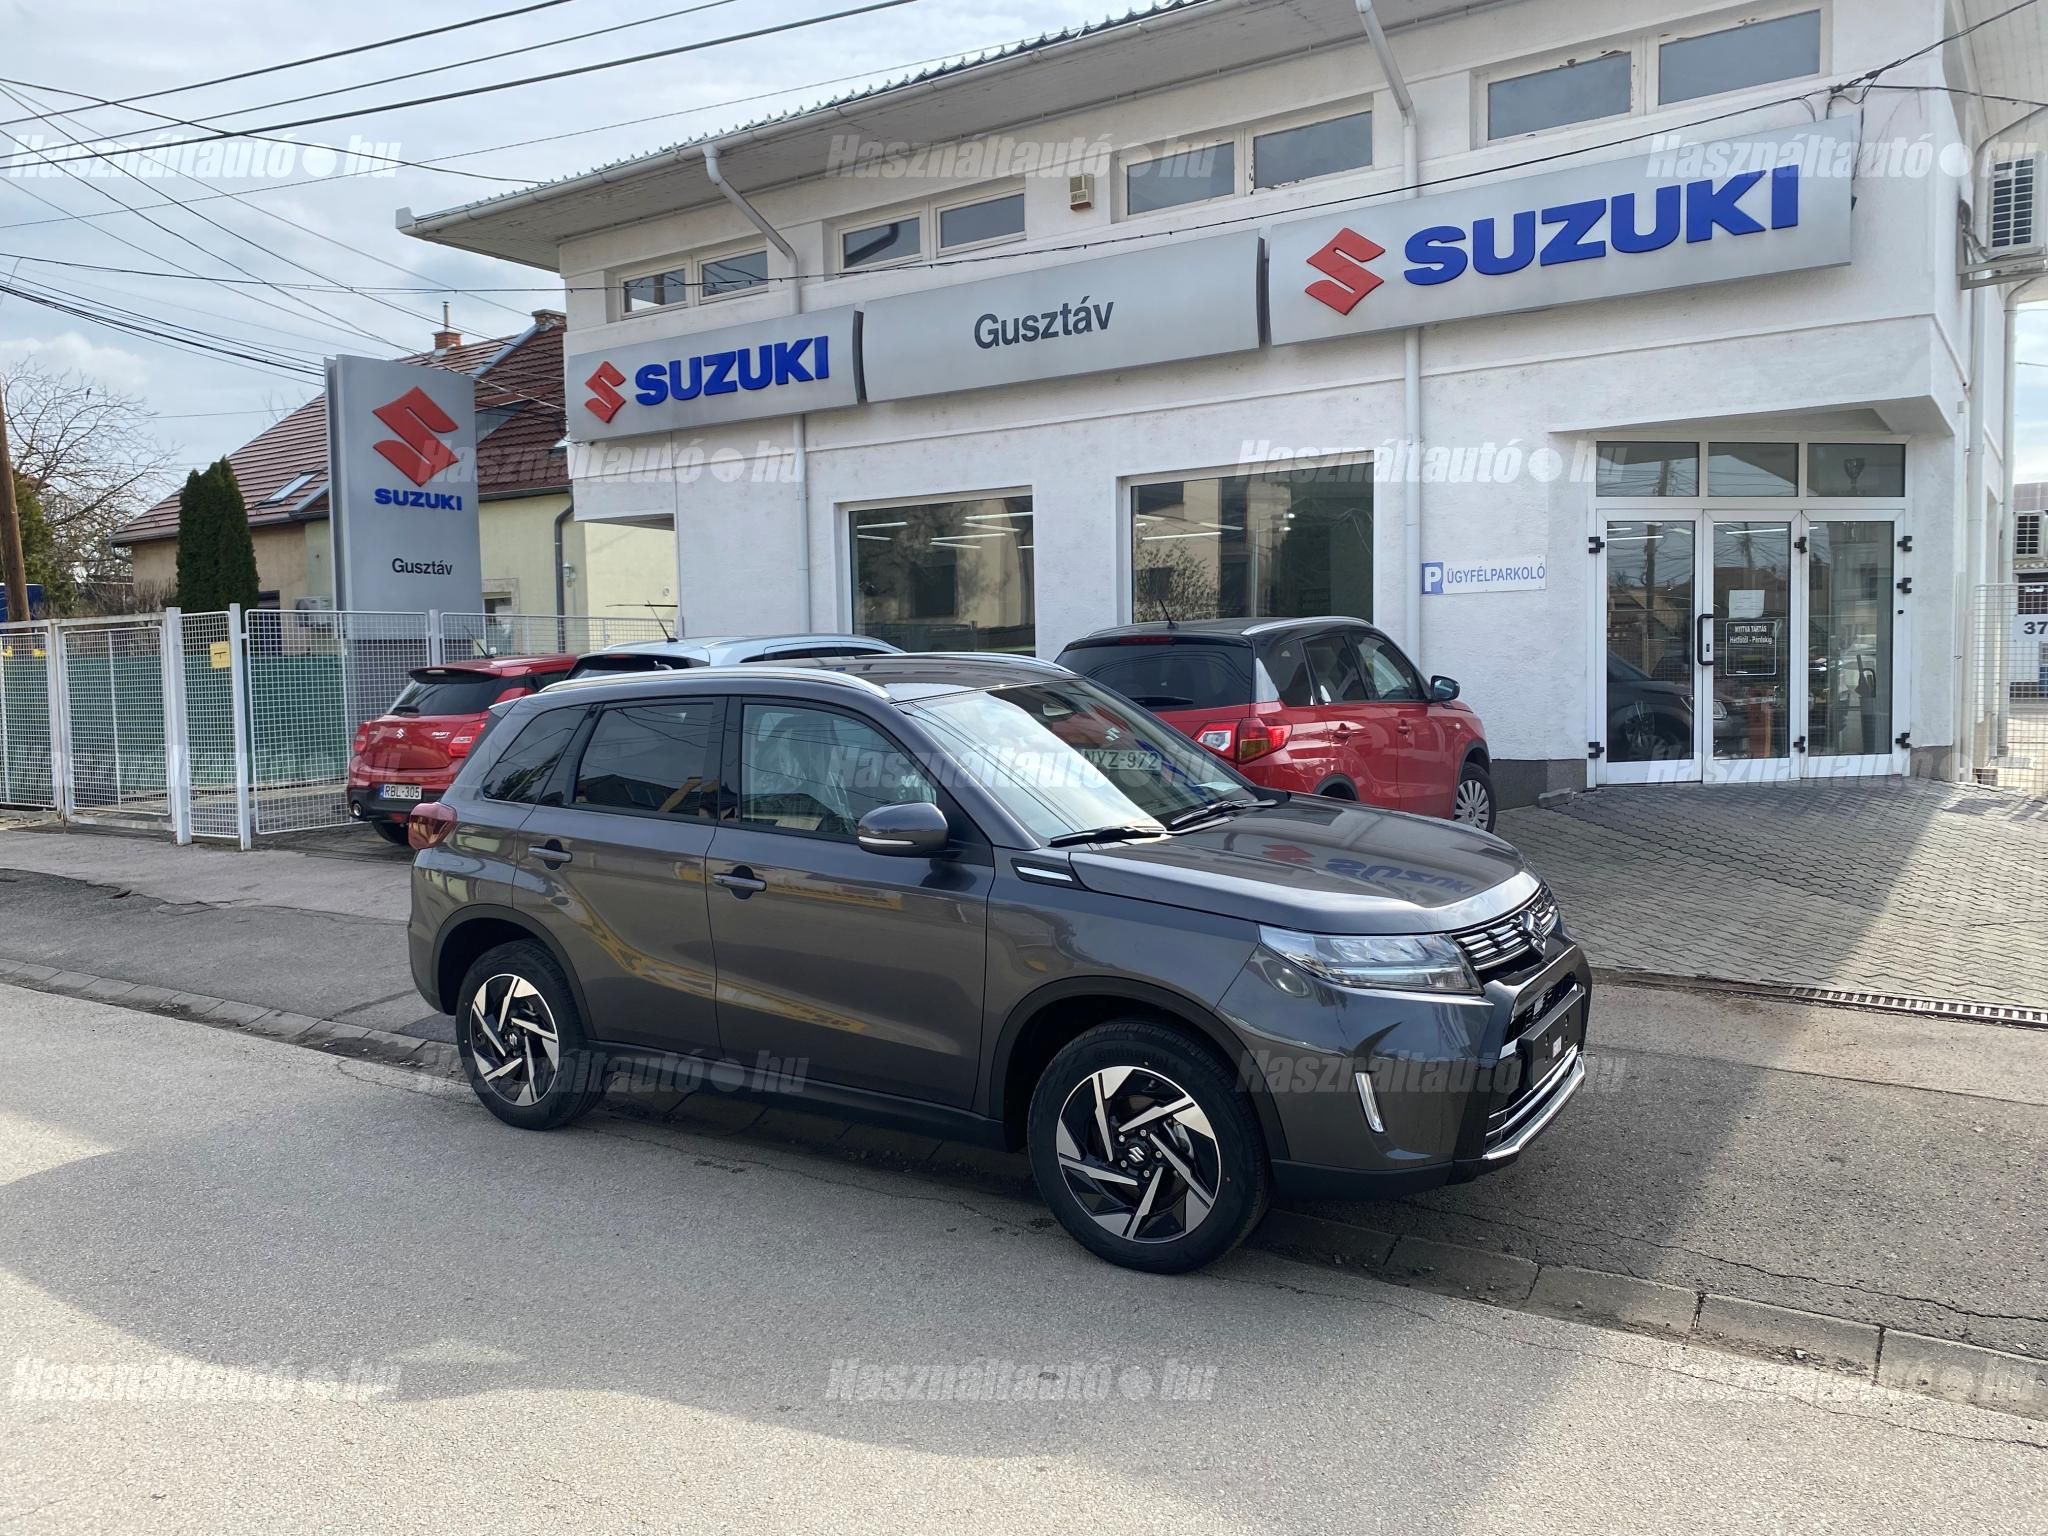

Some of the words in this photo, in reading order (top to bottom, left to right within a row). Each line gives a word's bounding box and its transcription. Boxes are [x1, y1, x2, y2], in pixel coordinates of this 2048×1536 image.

[1404, 165, 1798, 285] SUZUKI
[974, 296, 1114, 349] Gusztáv
[635, 336, 829, 406] SUZUKI
[374, 488, 462, 511] SUZUKI
[392, 558, 453, 575] Gusztáv
[1447, 562, 1546, 584] ÜGYFÉLPARKOLÓ
[2023, 621, 2048, 635] 37
[385, 785, 420, 798] RBL-305
